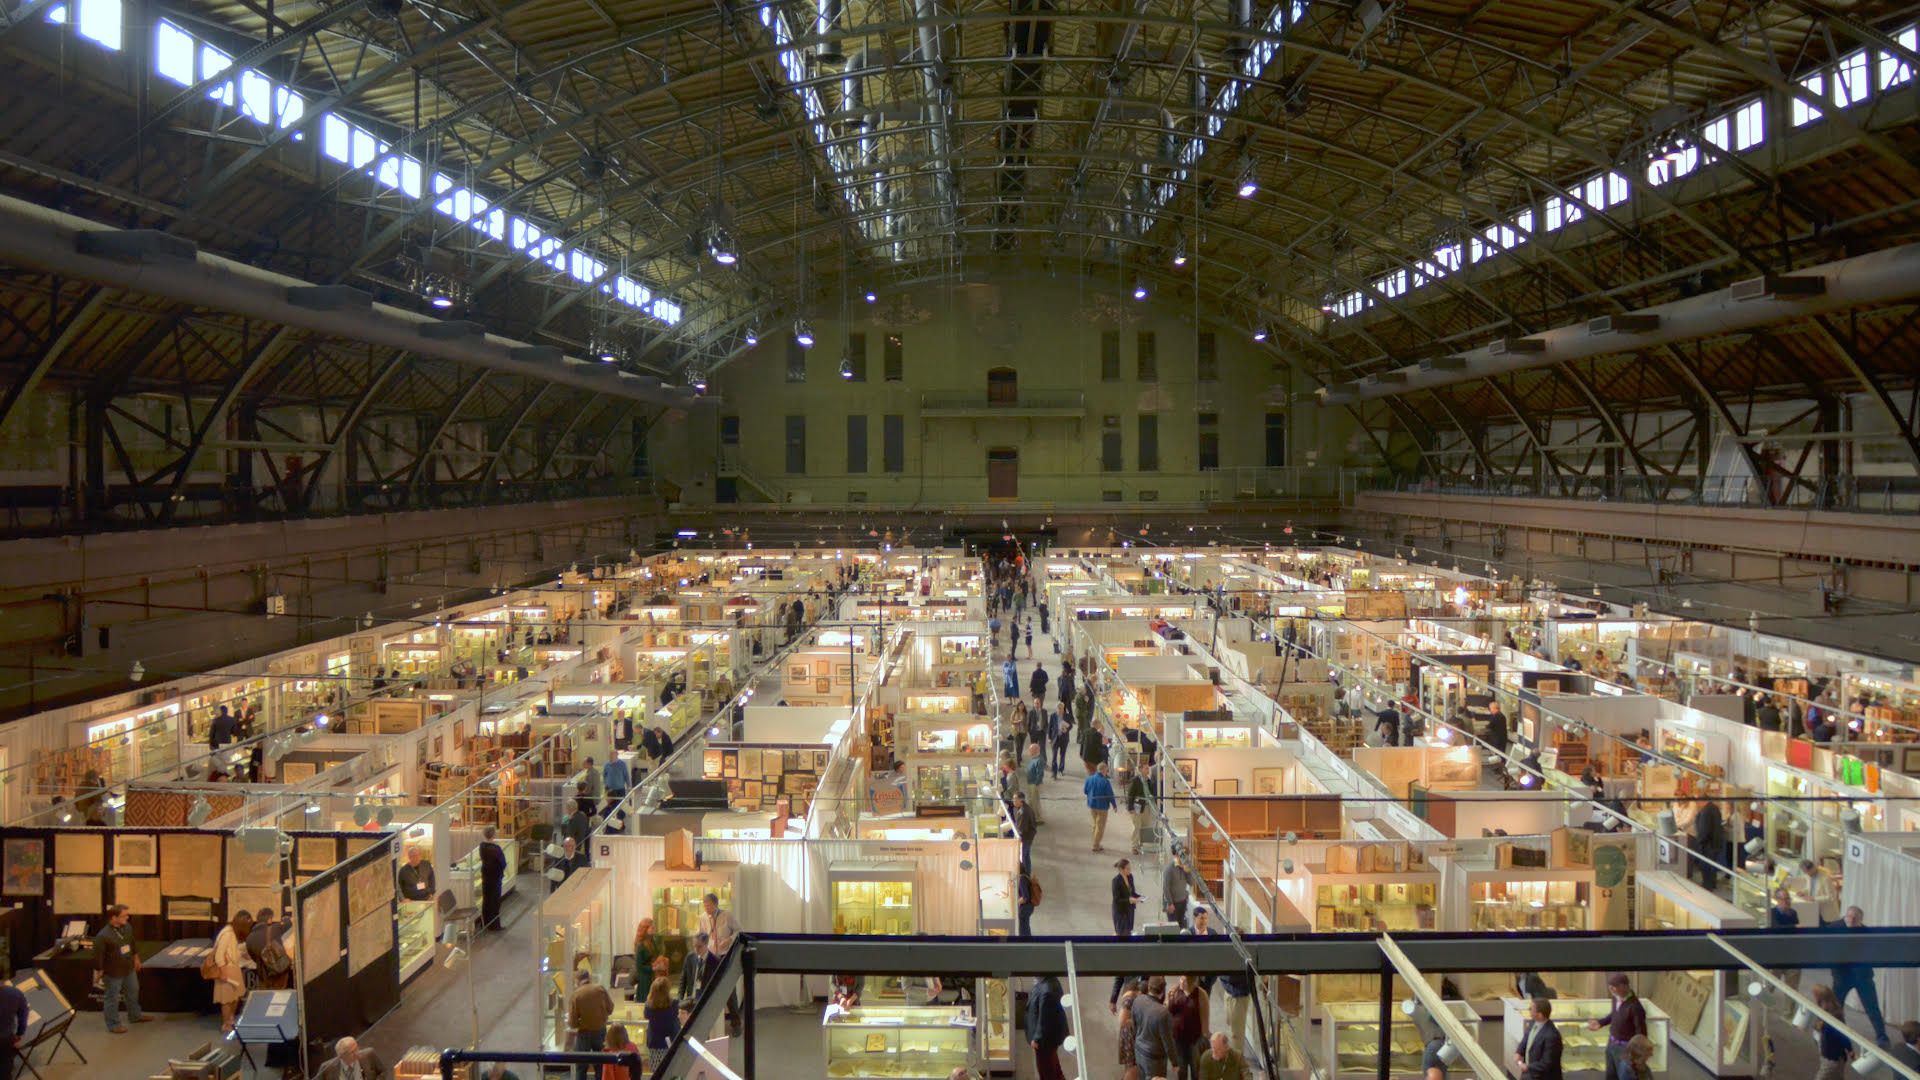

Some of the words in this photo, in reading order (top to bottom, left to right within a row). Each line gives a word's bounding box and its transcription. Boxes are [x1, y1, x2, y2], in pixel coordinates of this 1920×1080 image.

[600, 846, 610, 856] B
[1660, 845, 1666, 856] D
[1852, 845, 1860, 857] D
